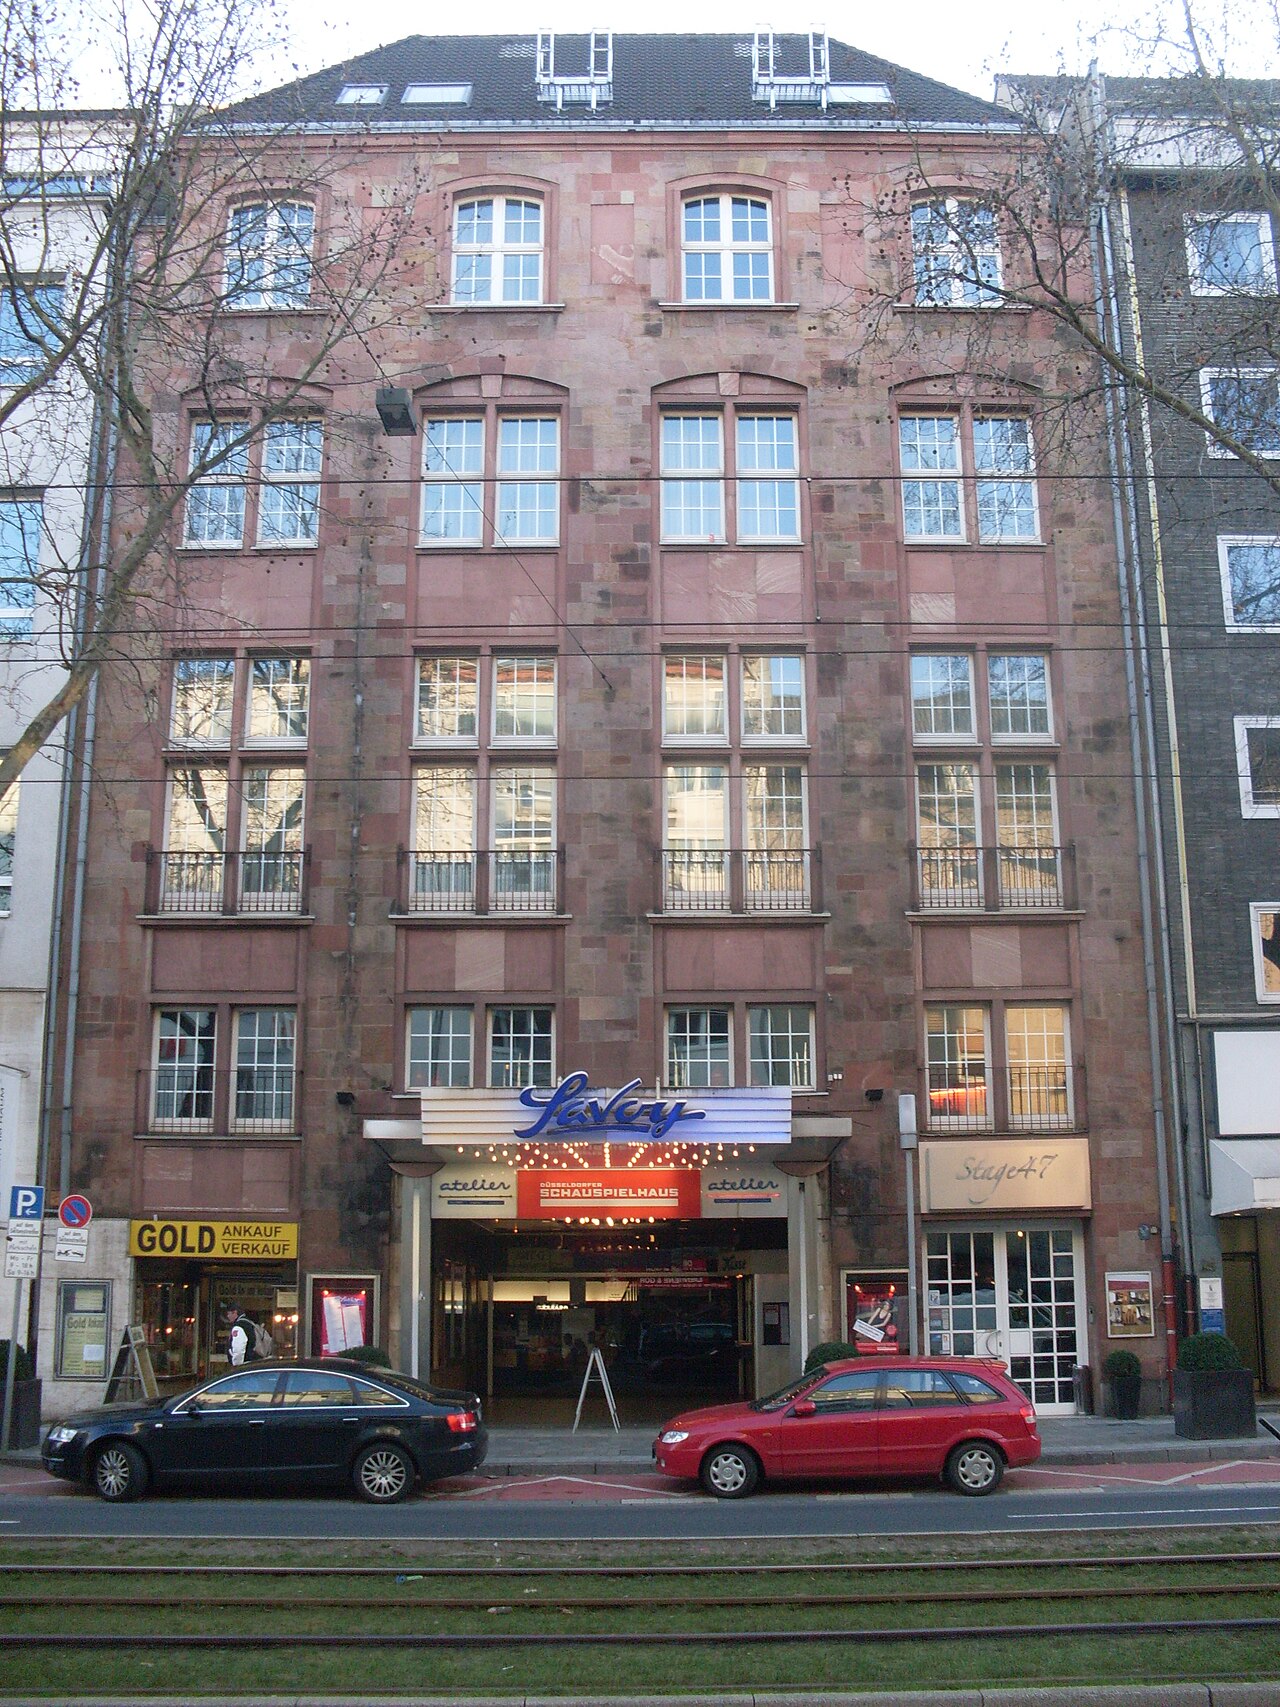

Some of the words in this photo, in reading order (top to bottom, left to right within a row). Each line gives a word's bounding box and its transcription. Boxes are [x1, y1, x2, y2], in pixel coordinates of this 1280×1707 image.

[513, 1070, 706, 1139] Savoy
[440, 1178, 511, 1191] atelier
[708, 1178, 779, 1191] atelier
[955, 1154, 1059, 1205] Stage47
[540, 1188, 679, 1198] SCHAUSPIELHAUS
[16, 1189, 37, 1216] P
[222, 1225, 282, 1238] ANKAUF
[137, 1223, 216, 1254] GOLD
[222, 1242, 291, 1255] VERKAUF
